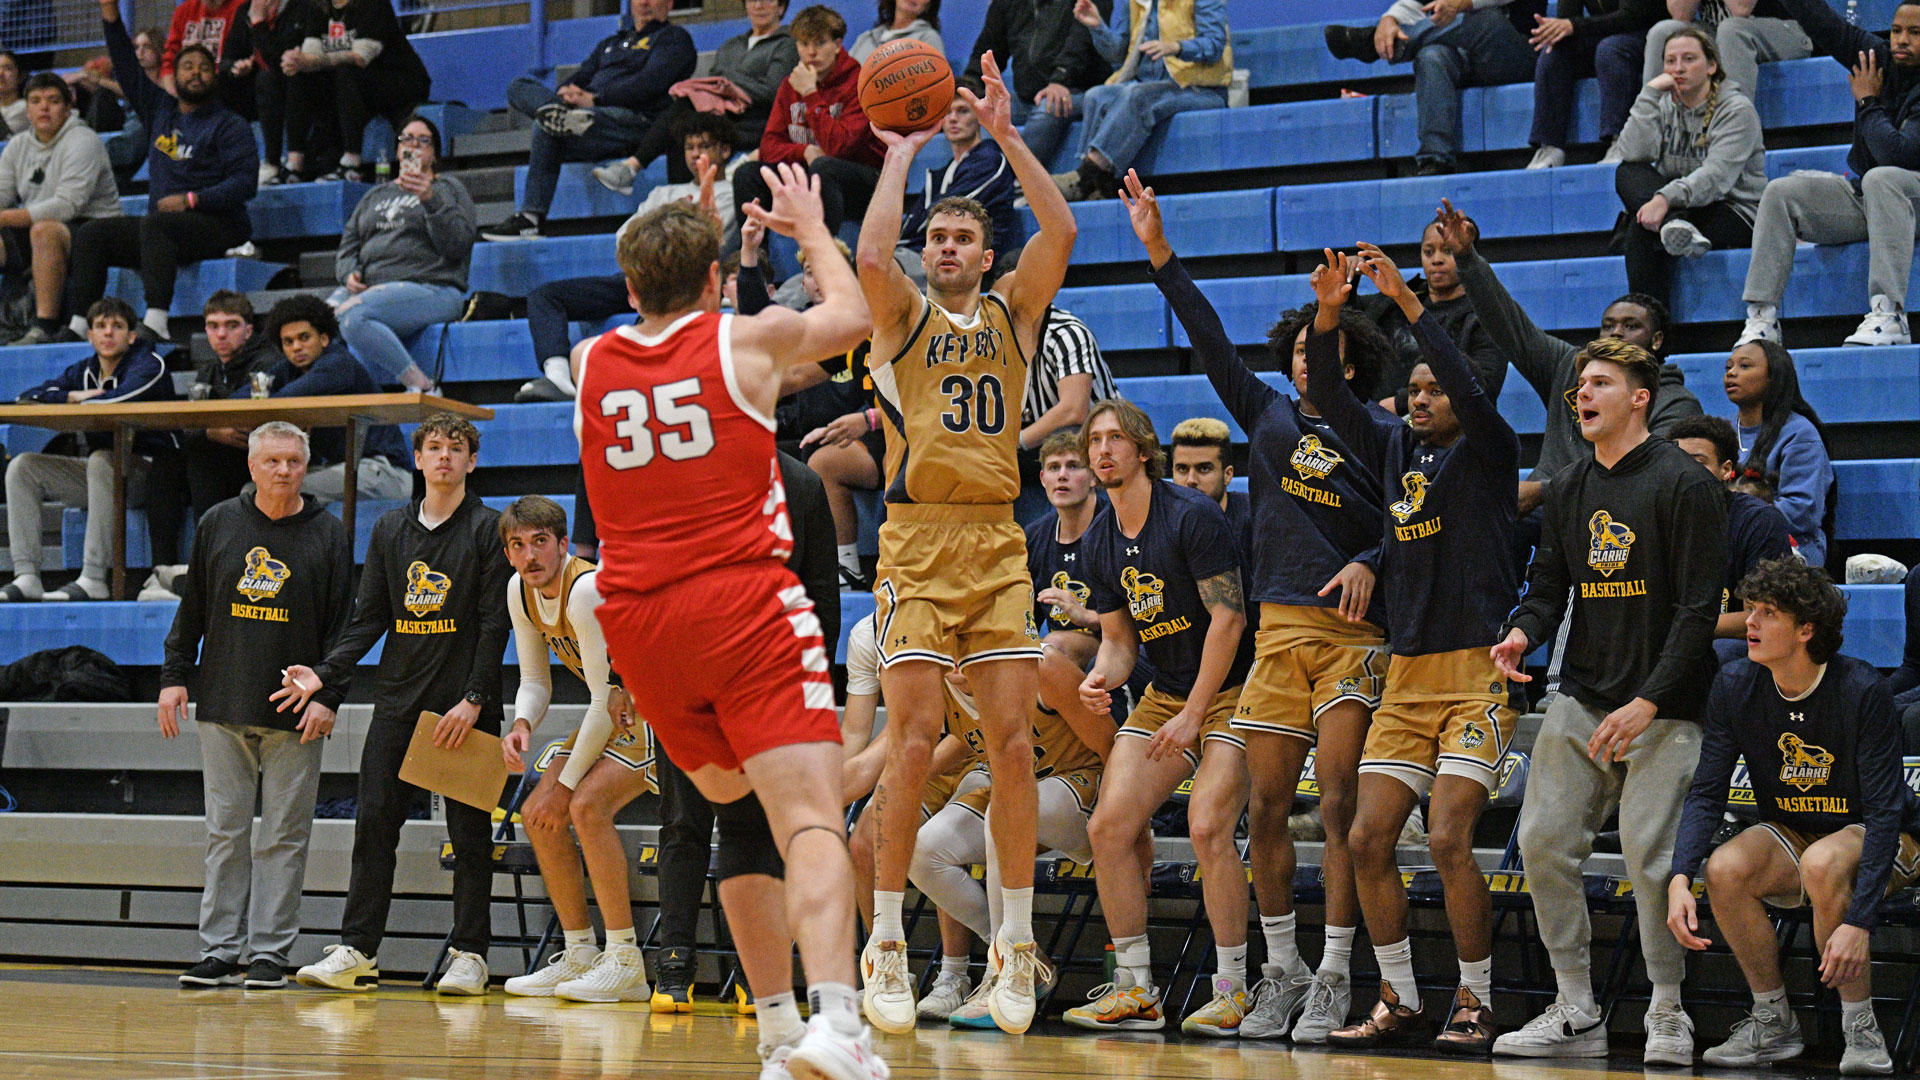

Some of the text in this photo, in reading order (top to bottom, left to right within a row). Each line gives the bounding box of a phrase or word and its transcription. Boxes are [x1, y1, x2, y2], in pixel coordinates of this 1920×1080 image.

[873, 58, 936, 95] SPALDING
[926, 332, 969, 369] KEY
[940, 373, 1007, 436] 30
[598, 375, 717, 472] 35
[1292, 451, 1335, 473] CLARKE
[1590, 549, 1628, 564] CLARKE
[239, 577, 282, 592] CLARKE
[1580, 579, 1647, 599] BASKETBALL
[404, 592, 445, 606] CLARKE
[1130, 594, 1162, 616] CLARKE
[395, 618, 457, 635] BASKETBALL
[1138, 615, 1192, 643] ASKEBALL
[1782, 766, 1830, 779] CLARKE
[1775, 797, 1849, 814] BASKETBALL
